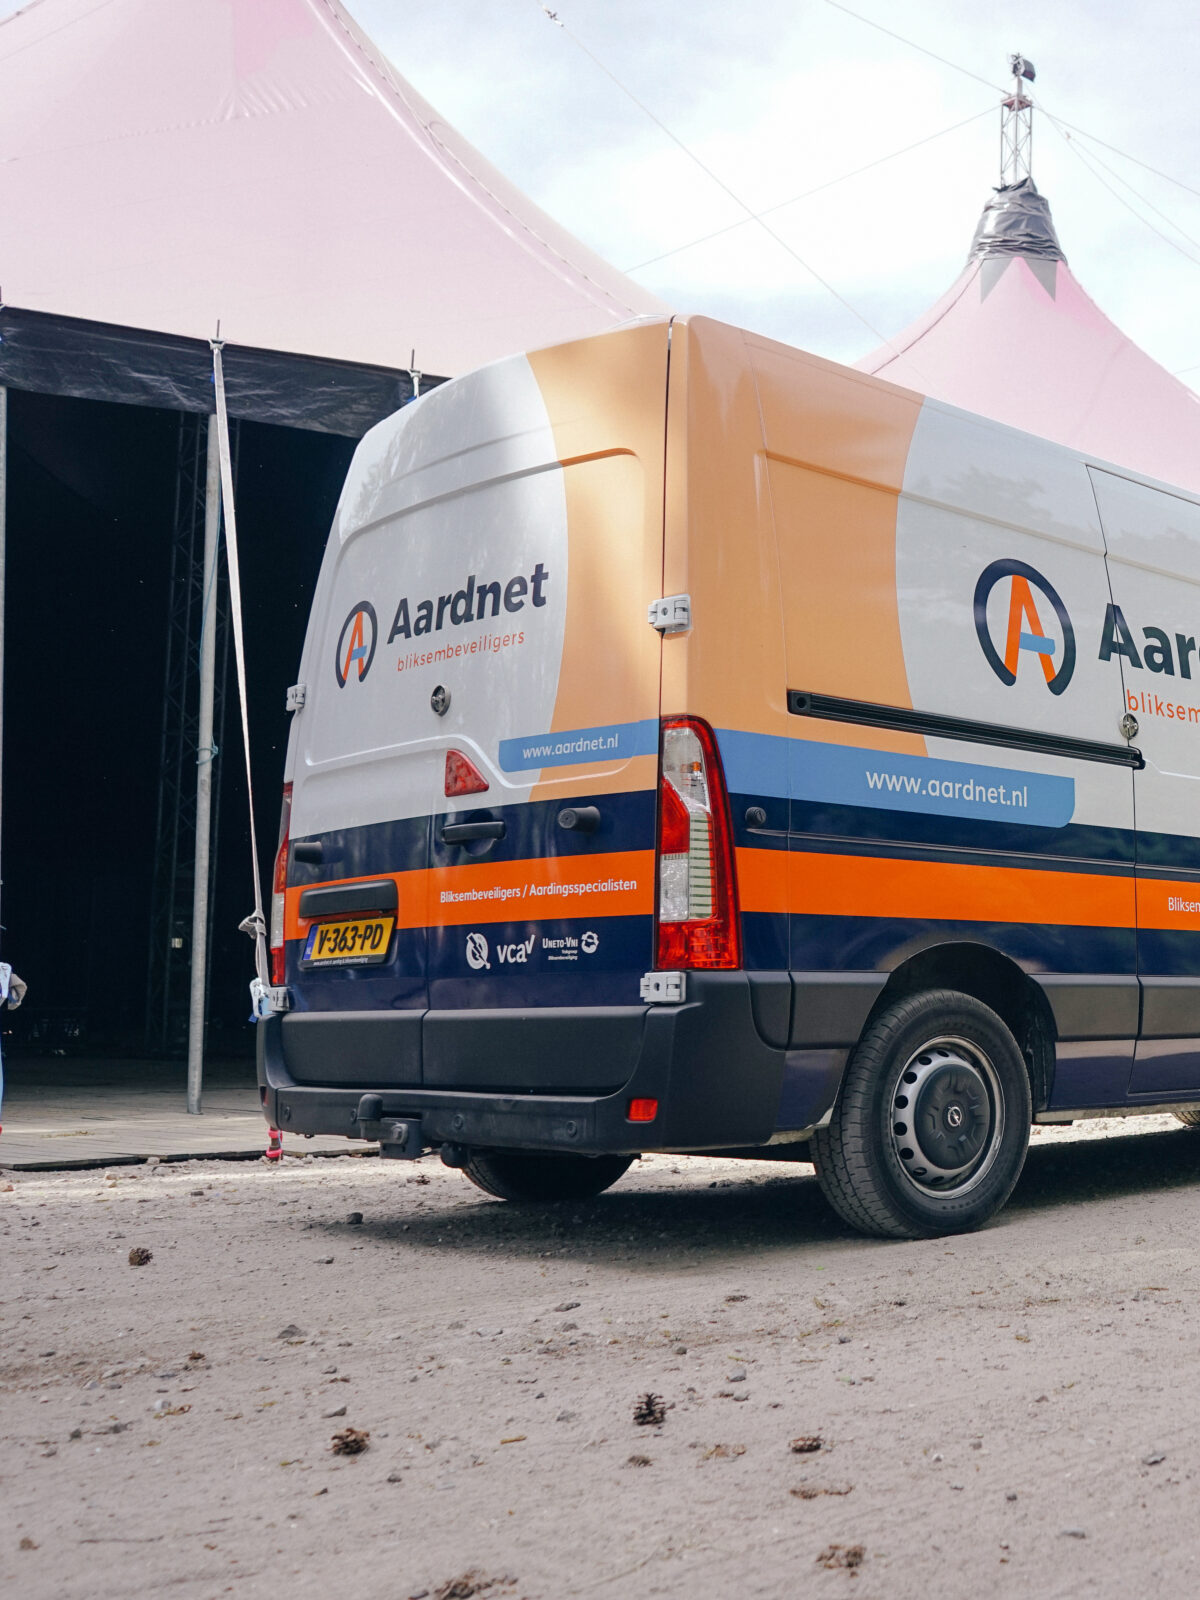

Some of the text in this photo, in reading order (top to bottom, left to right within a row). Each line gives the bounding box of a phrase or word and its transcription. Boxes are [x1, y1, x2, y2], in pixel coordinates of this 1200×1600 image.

[387, 563, 549, 645] Aardnet
[397, 631, 525, 672] bliksembeveiligers
[523, 733, 619, 759] www.aardnet.nl
[865, 770, 1028, 808] www.aardnet.nl
[440, 883, 521, 903] Bliksembeveiligers
[529, 879, 637, 897] Aardingsspecialisten
[318, 923, 384, 954] V-363-PD
